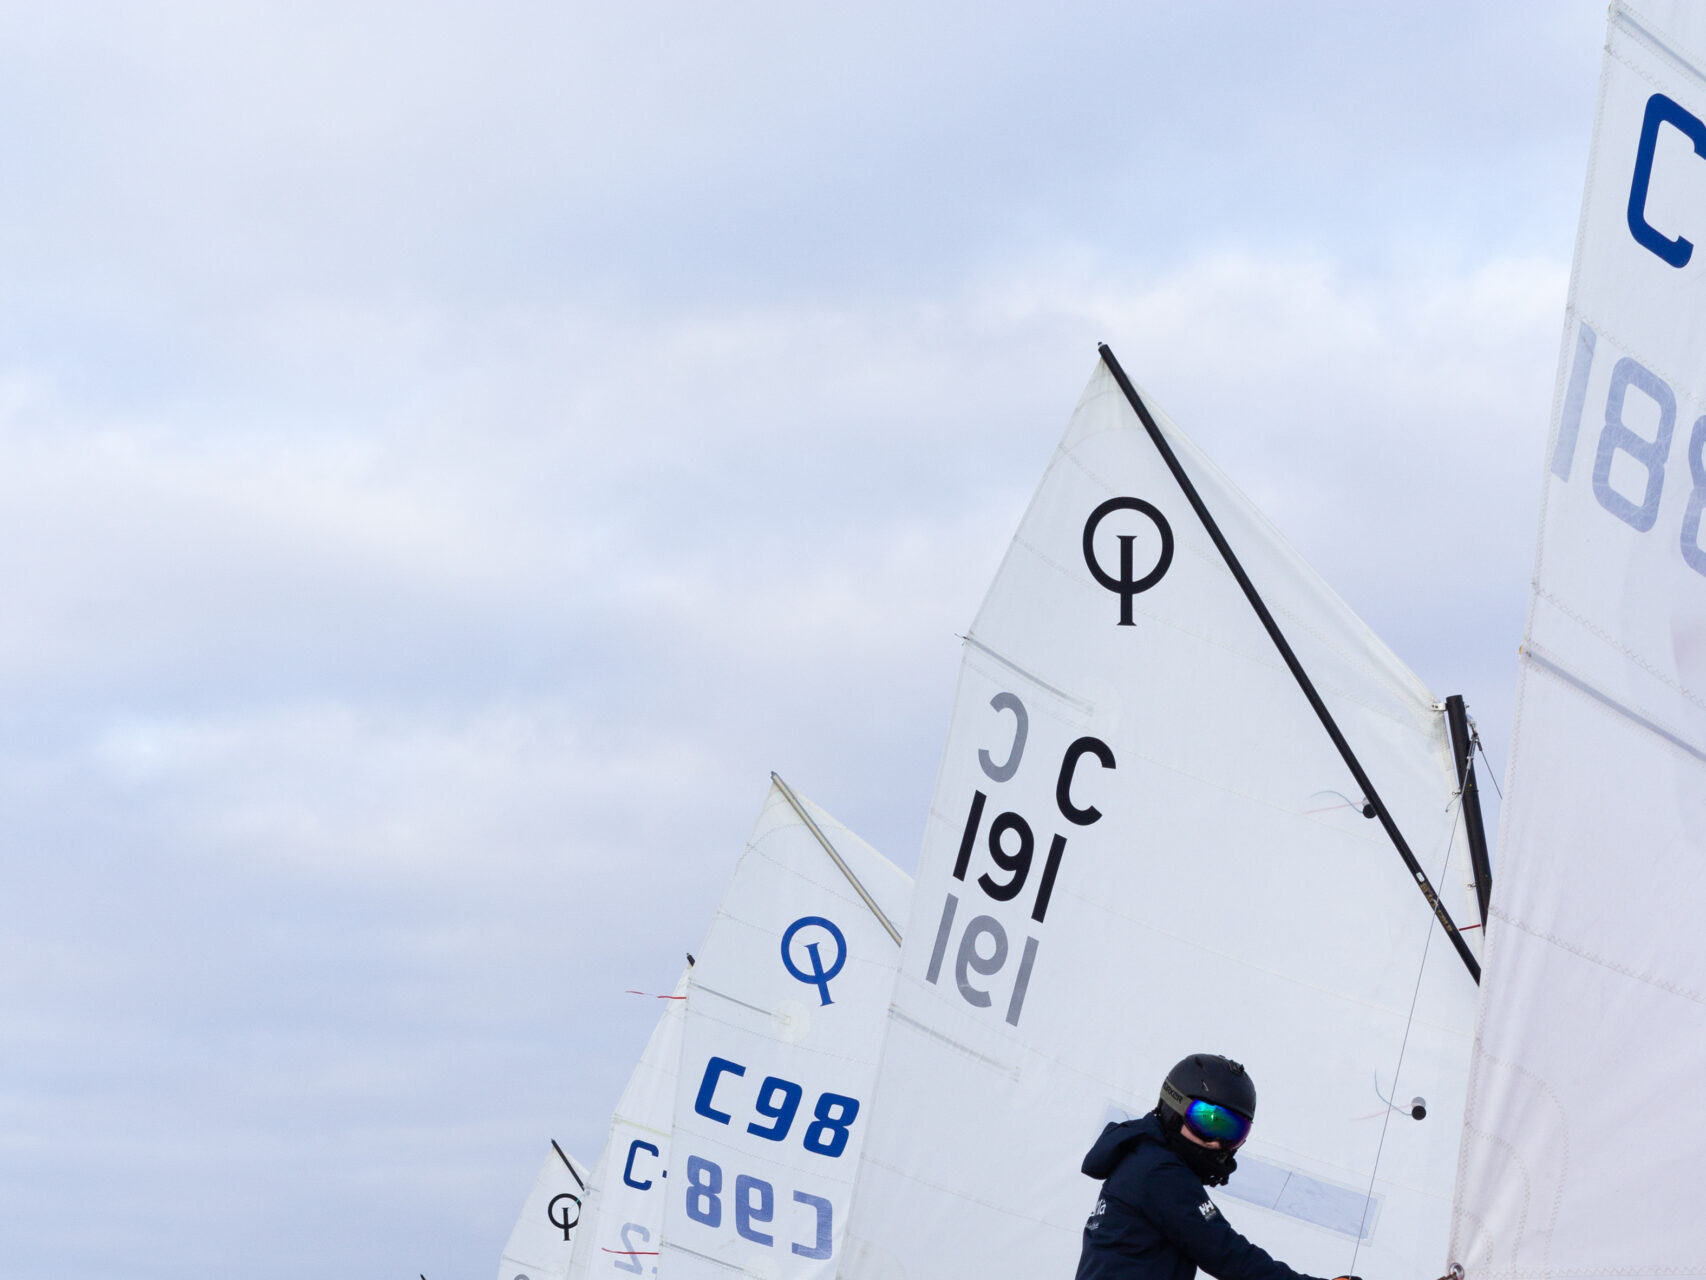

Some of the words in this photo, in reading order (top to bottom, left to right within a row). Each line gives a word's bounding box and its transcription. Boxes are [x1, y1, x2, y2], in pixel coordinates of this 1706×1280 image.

[1055, 736, 1116, 826] C
[952, 789, 1067, 923] 191
[694, 1056, 859, 1158] C98
